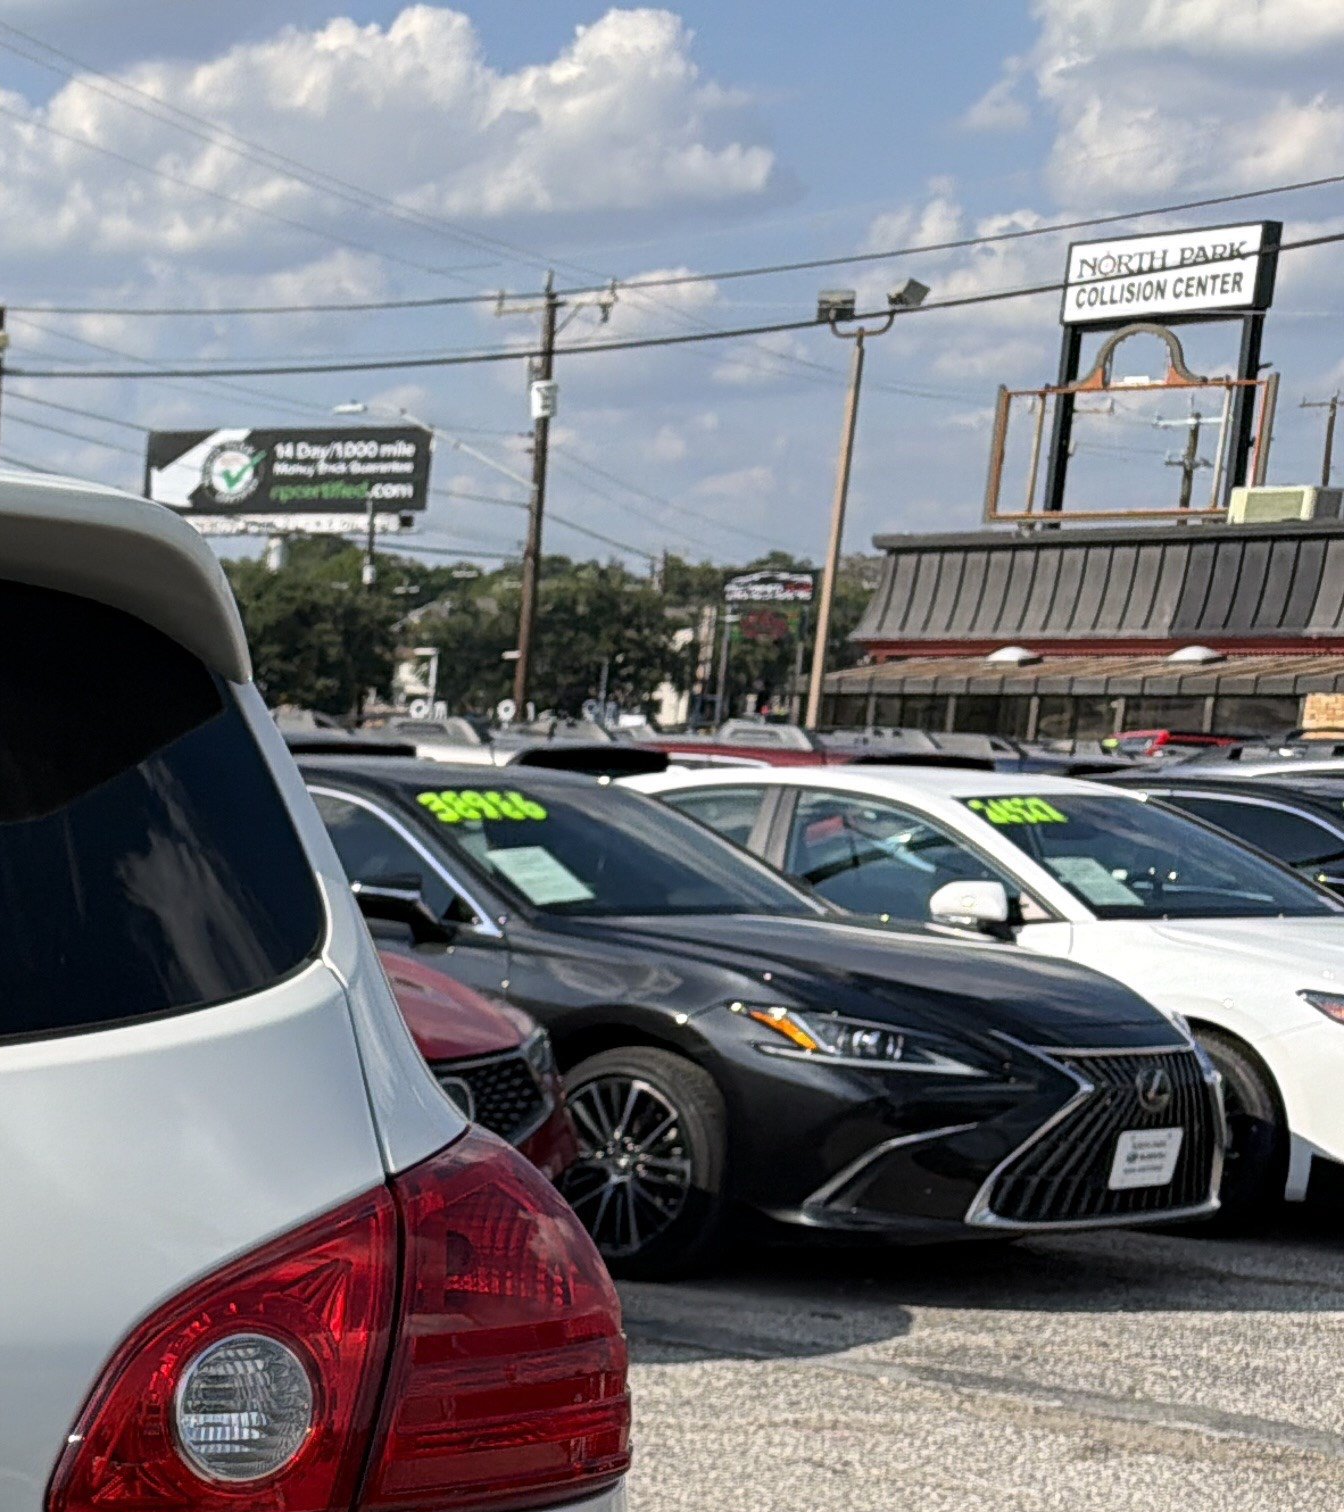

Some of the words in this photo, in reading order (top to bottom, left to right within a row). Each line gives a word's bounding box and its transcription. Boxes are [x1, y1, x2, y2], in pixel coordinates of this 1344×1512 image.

[1077, 248, 1167, 278] NORTH
[1179, 240, 1248, 268] PARK
[1075, 278, 1167, 308] COLLISION
[1171, 271, 1244, 299] CENTER
